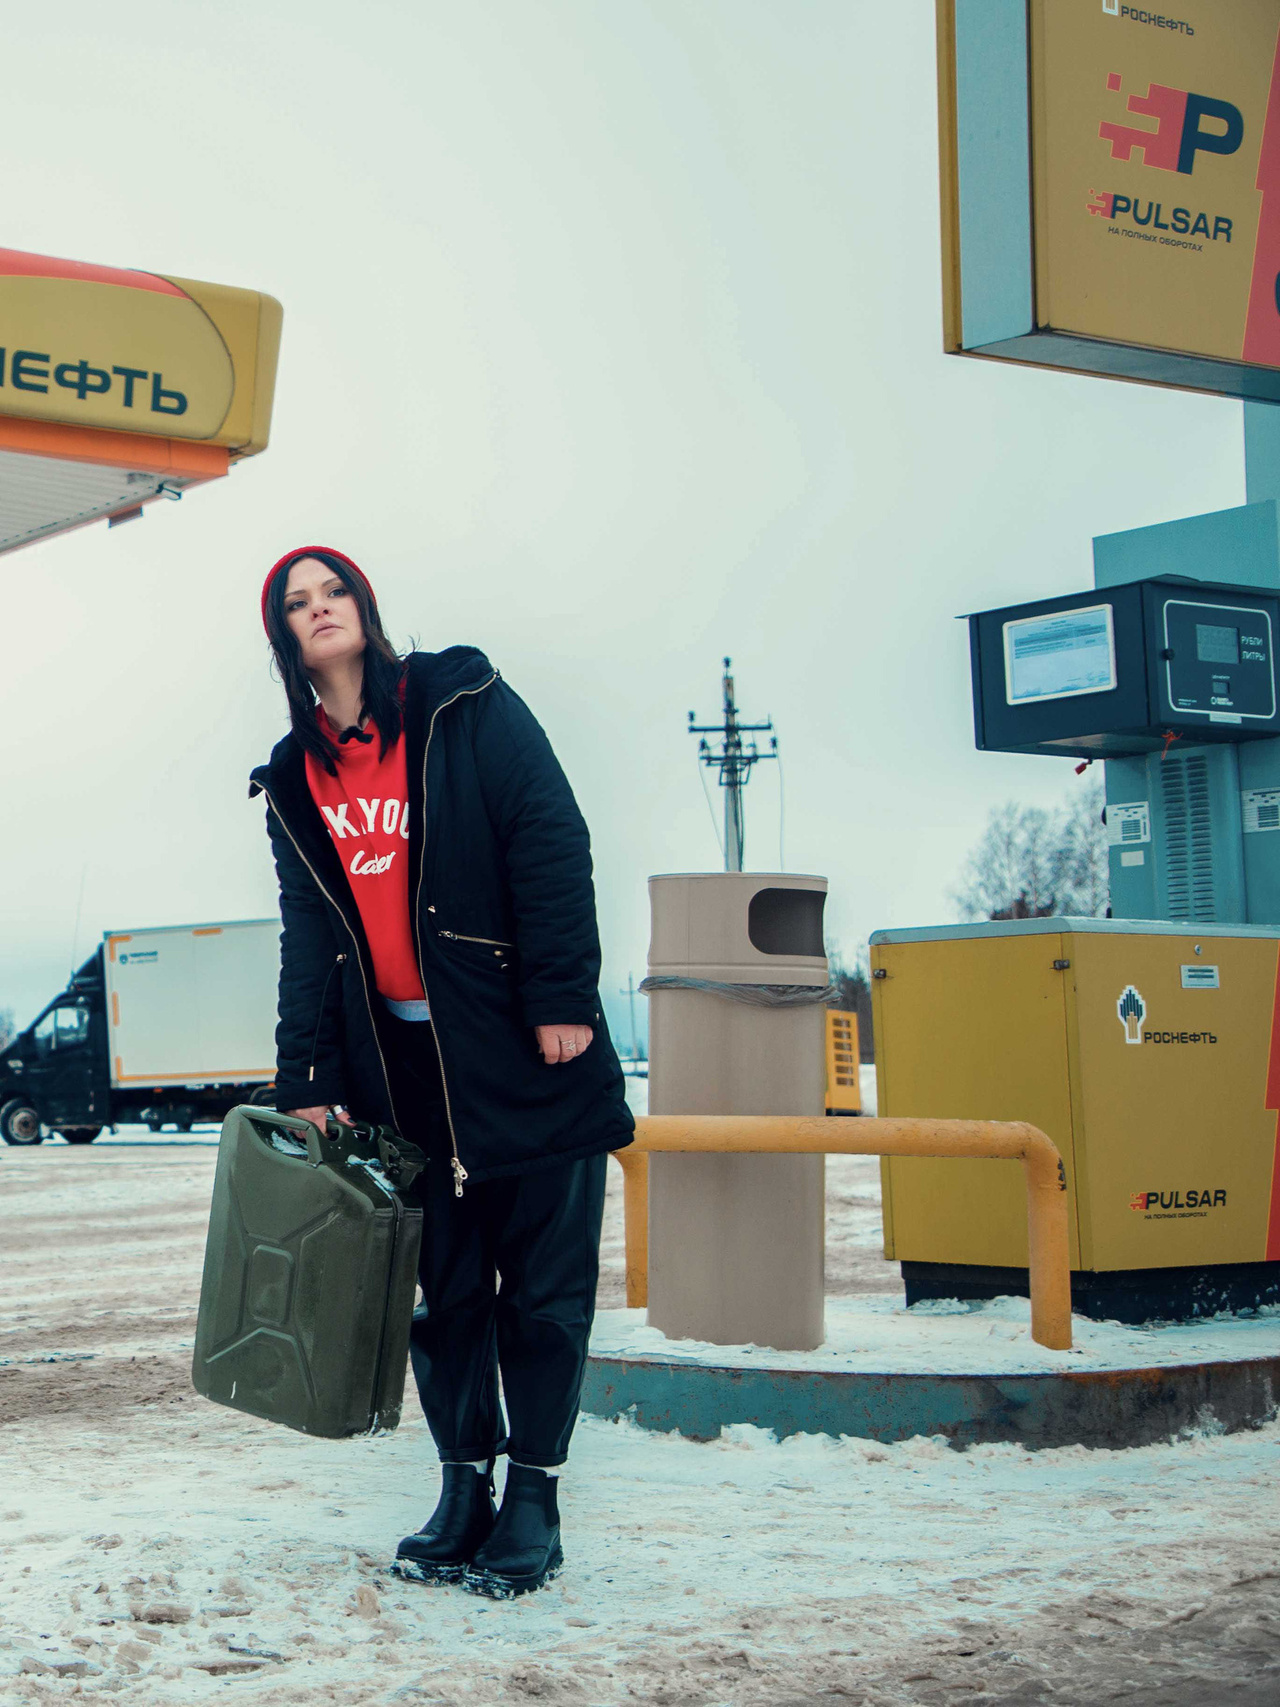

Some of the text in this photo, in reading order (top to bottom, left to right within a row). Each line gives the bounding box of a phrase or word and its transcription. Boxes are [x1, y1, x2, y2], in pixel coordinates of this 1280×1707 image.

[1121, 5, 1195, 36] РОСНЕФТЬ
[1111, 194, 1233, 243] PULSAR
[1108, 226, 1203, 252] НА ПОЛНЫХ ОБОРОТАХ
[1242, 651, 1266, 661] ЛИТРЫ
[321, 803, 361, 839] K
[1144, 1032, 1217, 1043] РОСНЕФТЬ
[1146, 1189, 1227, 1210] PULSAR
